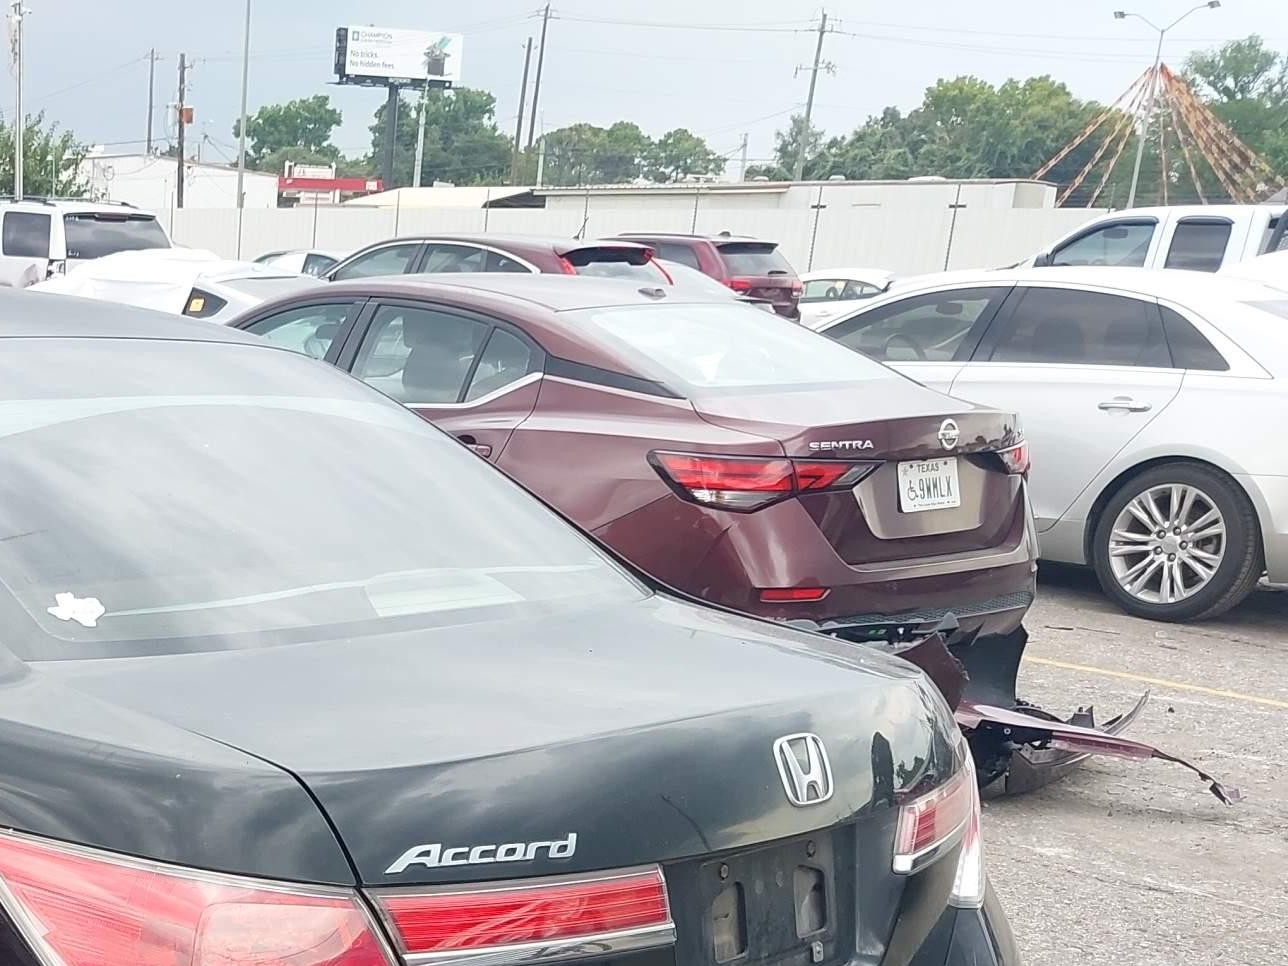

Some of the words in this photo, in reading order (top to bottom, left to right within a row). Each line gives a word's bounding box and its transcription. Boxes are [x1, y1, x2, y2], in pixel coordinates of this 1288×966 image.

[350, 49, 360, 58] No
[350, 59, 359, 68] No
[360, 60, 381, 68] hidden
[808, 439, 874, 451] SENTRA
[917, 463, 939, 473] TEXAS
[384, 833, 577, 875] Accord
